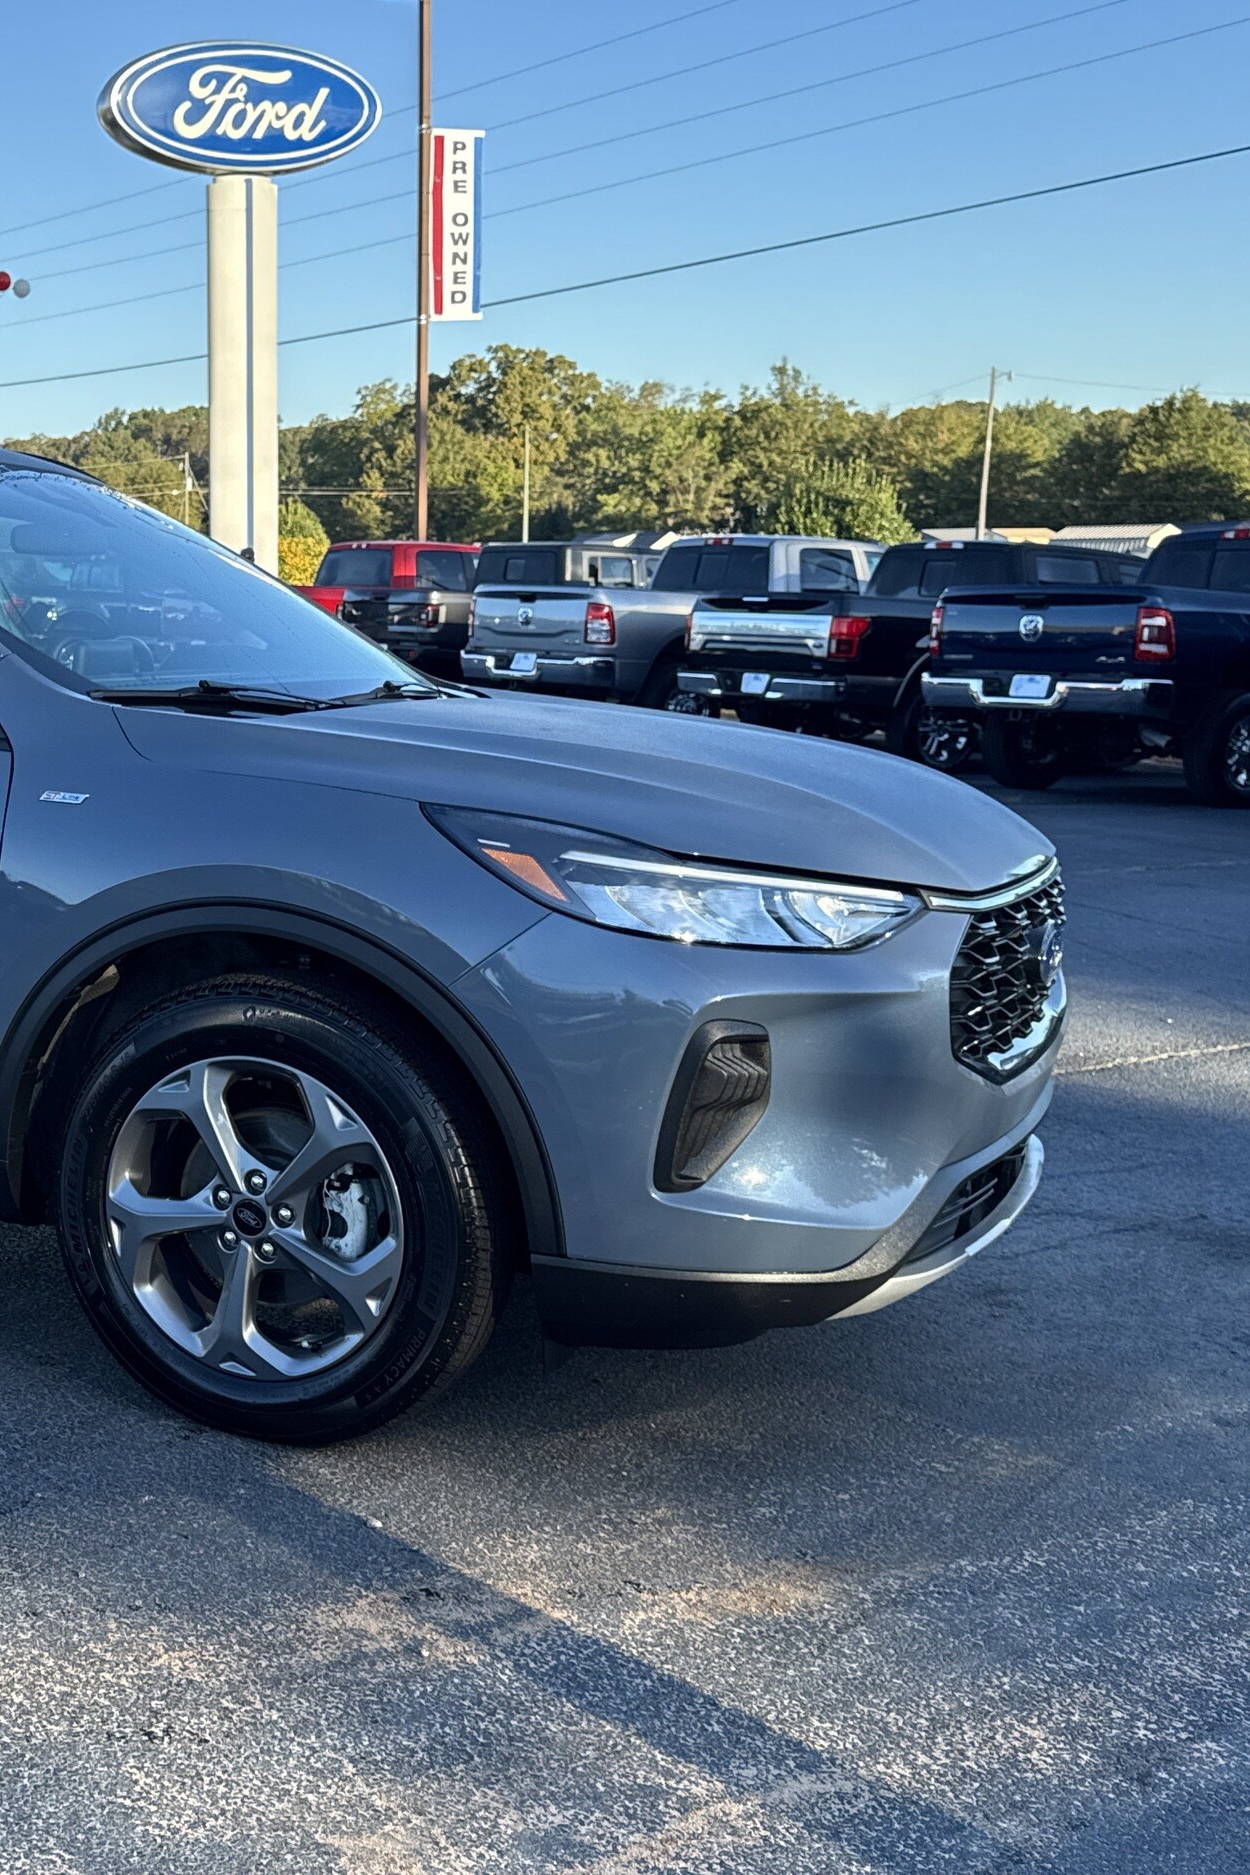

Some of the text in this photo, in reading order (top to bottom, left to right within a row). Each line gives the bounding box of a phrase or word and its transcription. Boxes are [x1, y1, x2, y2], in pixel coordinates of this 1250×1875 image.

[173, 63, 331, 141] Ford
[449, 140, 470, 305] PRE OWNED
[384, 1327, 427, 1388] PRIMACY
